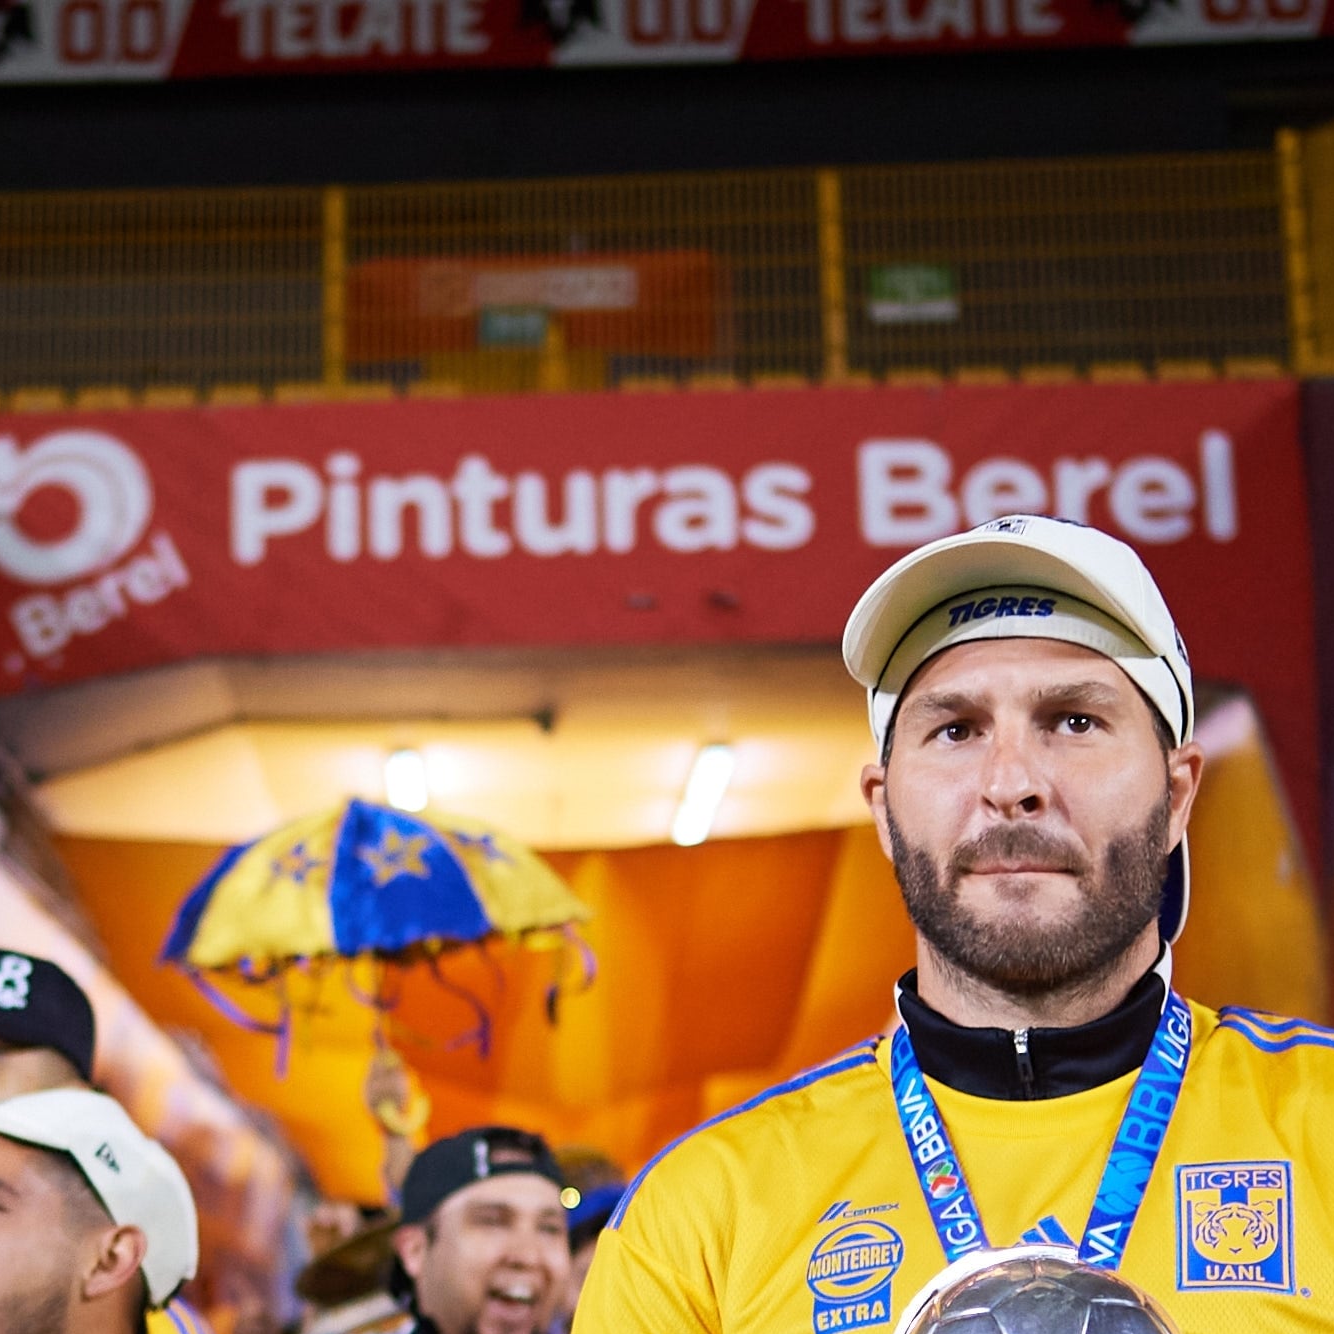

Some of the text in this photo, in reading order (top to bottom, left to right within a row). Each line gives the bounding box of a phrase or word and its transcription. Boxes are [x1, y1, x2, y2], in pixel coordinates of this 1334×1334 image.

[230, 428, 1239, 564] Pinturas Berel
[9, 532, 191, 658] Berel
[949, 597, 1056, 628] TIGRES
[1157, 1004, 1190, 1069] LIGA
[900, 1078, 947, 1165] BBVA
[1186, 1170, 1281, 1191] TIGRES
[940, 1195, 982, 1256] IGA
[808, 1242, 902, 1281] MONTERREY
[1205, 1264, 1266, 1282] UANL
[817, 1300, 886, 1331] EXTRA
